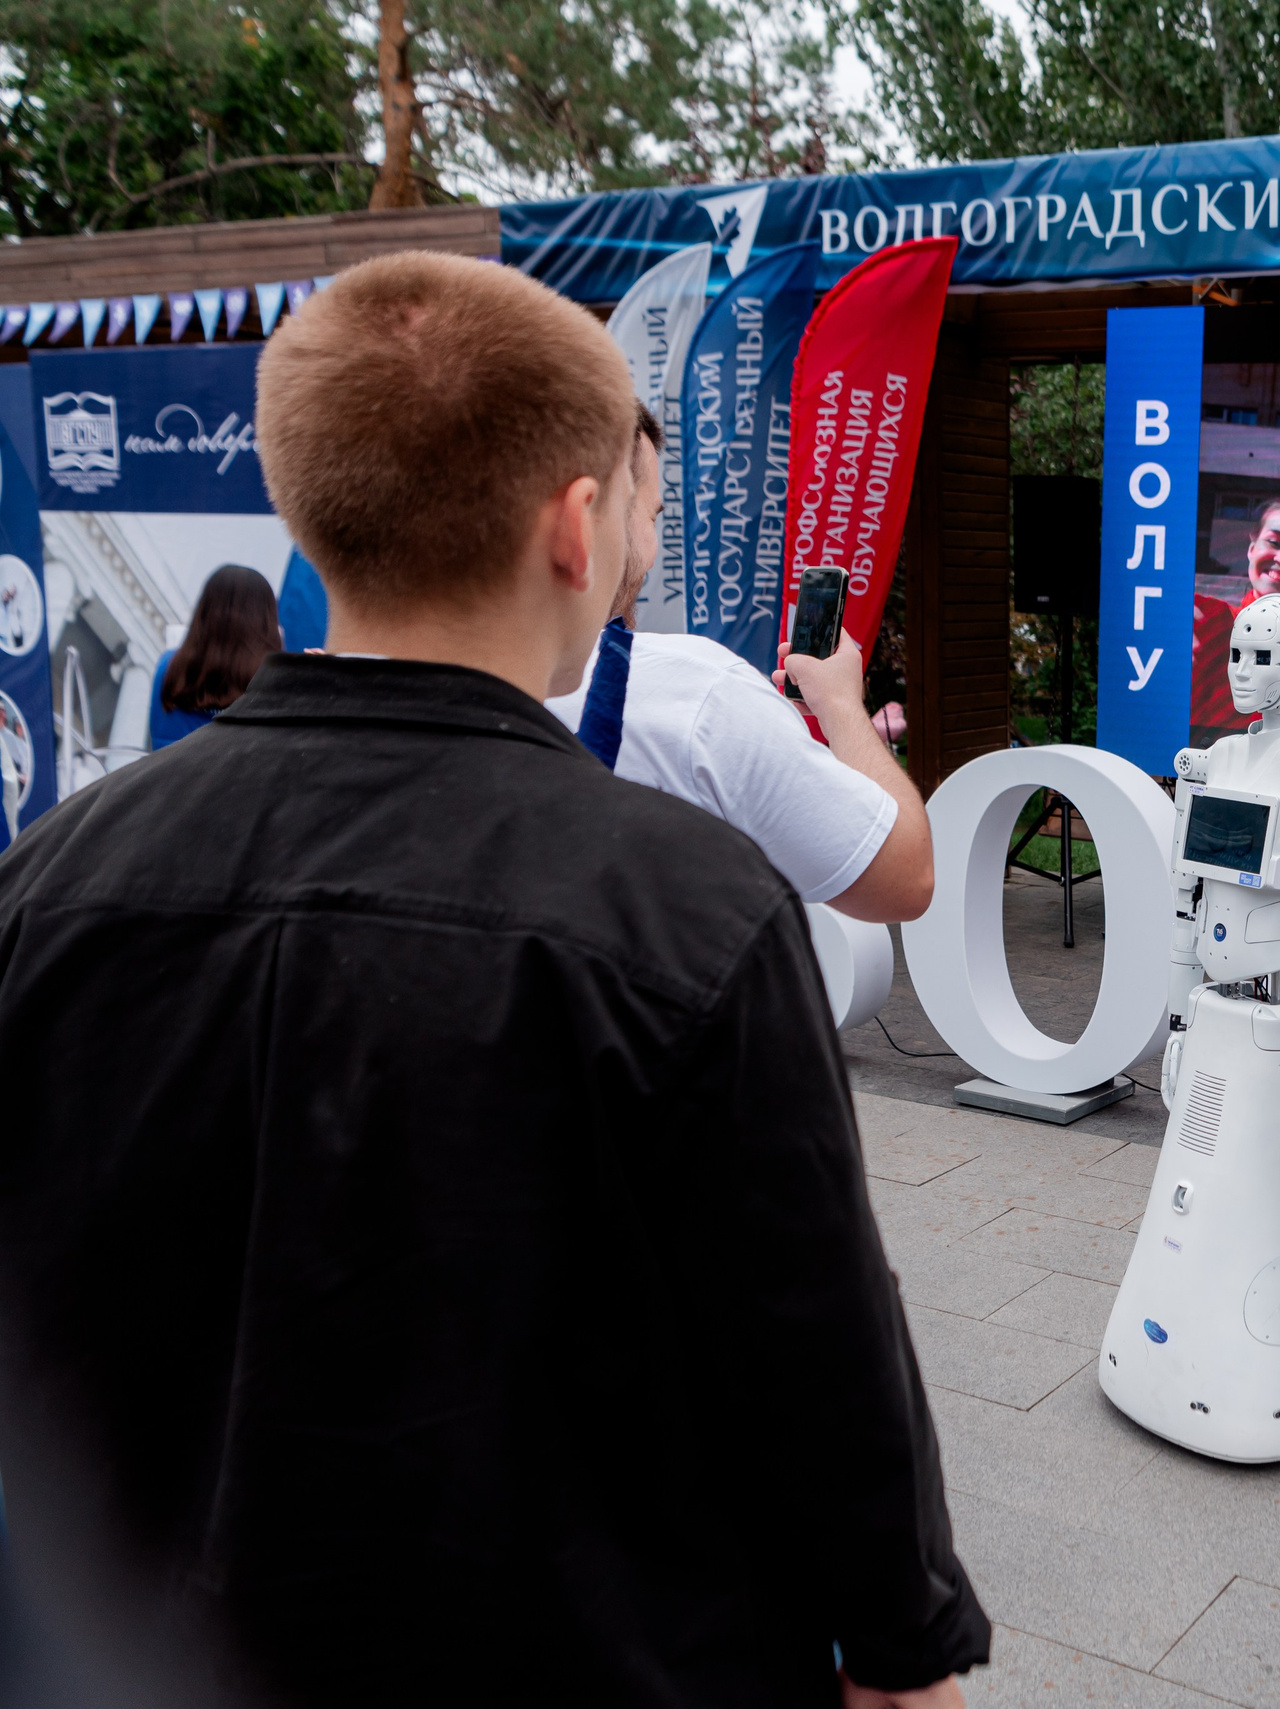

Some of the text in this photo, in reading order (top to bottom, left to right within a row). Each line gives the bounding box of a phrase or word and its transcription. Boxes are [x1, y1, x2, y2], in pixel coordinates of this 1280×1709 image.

[661, 392, 683, 605] УНИВЕРСИТЕТ
[750, 396, 791, 623] УНИВЕРСИТЕТ
[820, 388, 874, 567] РГАНИЗАЦИЯ
[848, 372, 908, 597] ОБУЧАЮЩИХСЯ
[1126, 400, 1172, 692] ВОЛГУ
